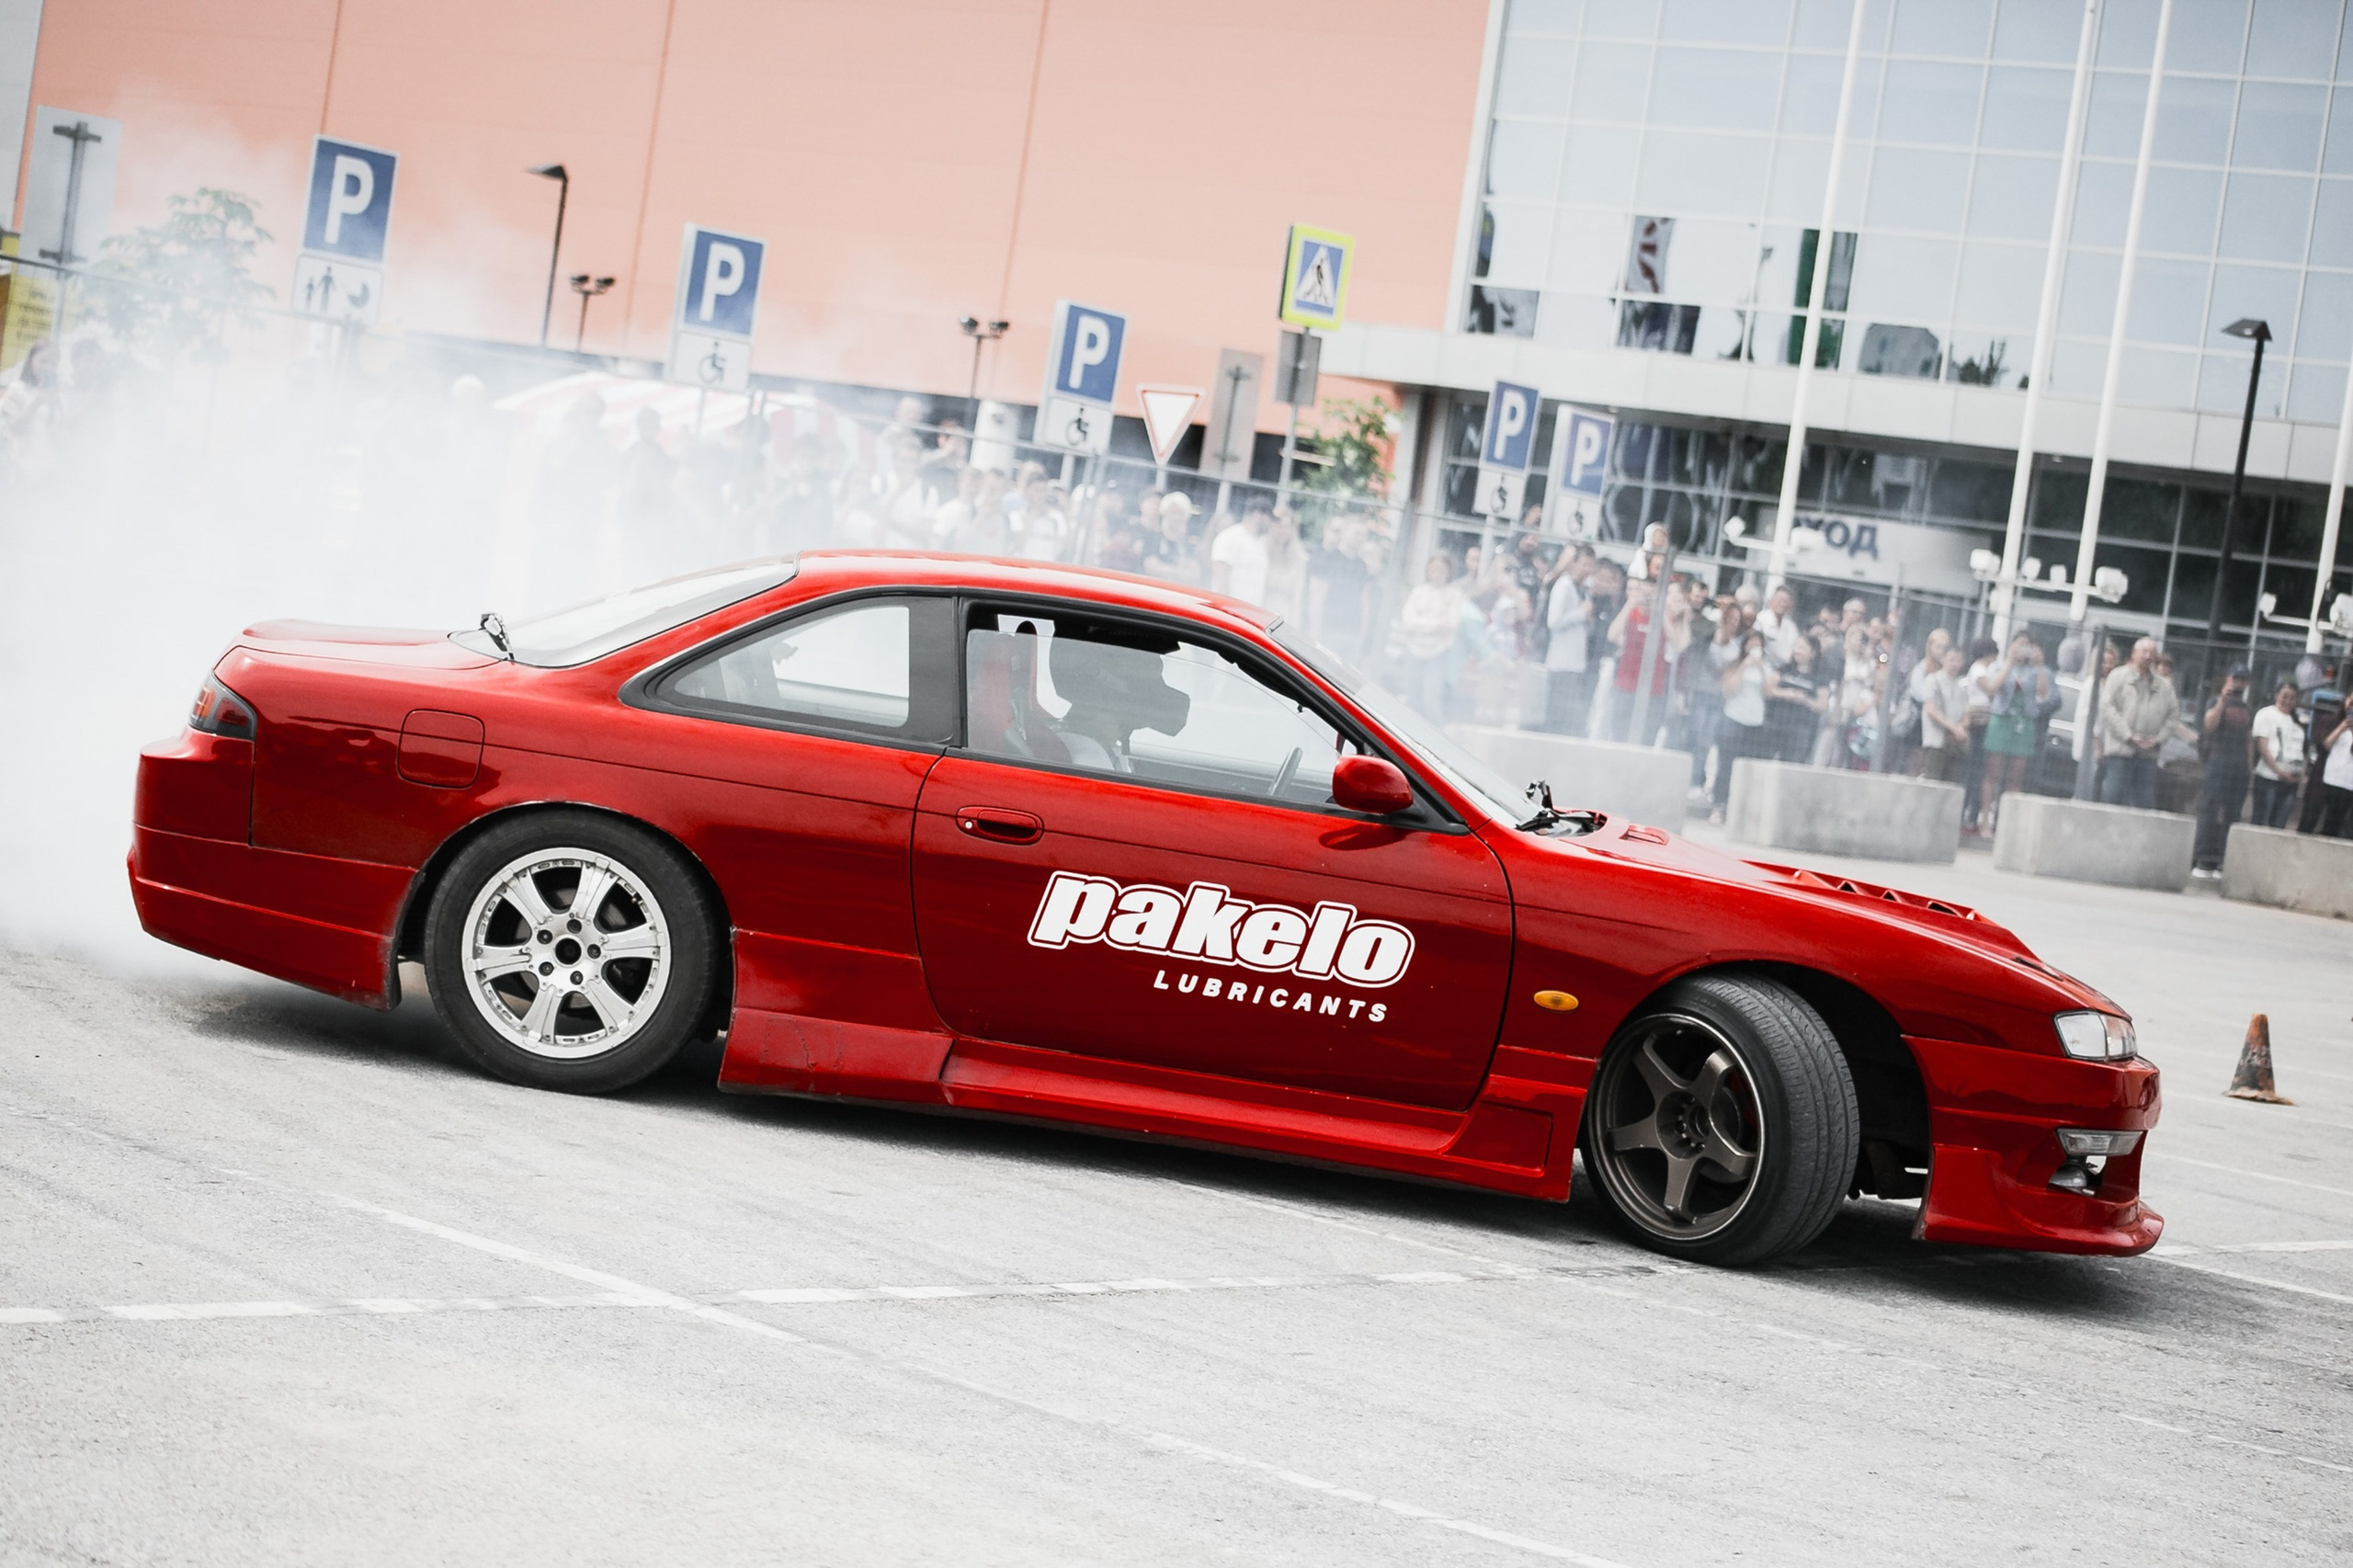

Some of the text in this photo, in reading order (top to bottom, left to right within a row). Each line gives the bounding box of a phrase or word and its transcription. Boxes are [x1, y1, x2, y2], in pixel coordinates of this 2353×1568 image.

[324, 153, 374, 244] P
[699, 241, 746, 323] P
[1068, 314, 1110, 390] P
[1494, 389, 1528, 460] P
[1570, 420, 1602, 486] P
[1791, 516, 1878, 560] ОД
[1027, 870, 1415, 988] pakelo
[1154, 971, 1387, 1022] LUBRICANTS
